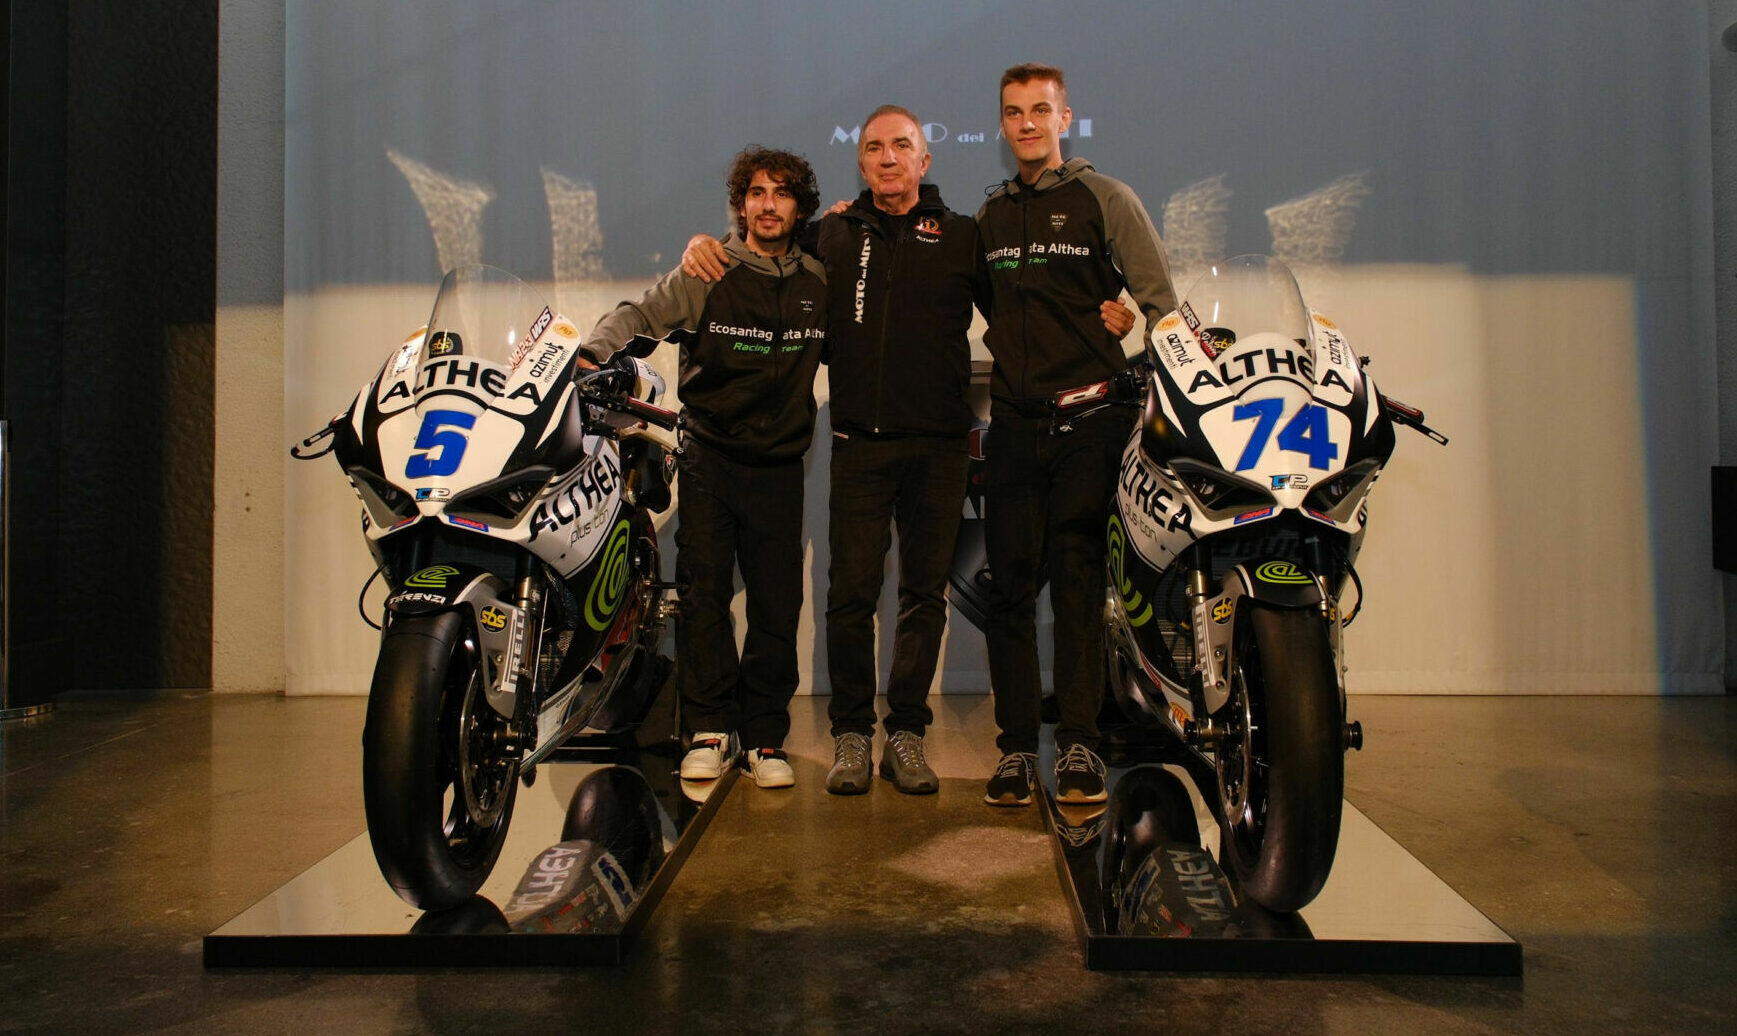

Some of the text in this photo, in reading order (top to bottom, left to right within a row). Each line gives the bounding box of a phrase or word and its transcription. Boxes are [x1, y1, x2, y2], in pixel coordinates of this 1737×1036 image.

[957, 132, 984, 143] dei
[915, 234, 940, 244] ALTHEA
[1048, 242, 1090, 256] Althea
[854, 279, 866, 324] MOTO
[709, 322, 773, 342] Ecosantag
[733, 342, 771, 354] Racing
[529, 341, 564, 378] azimut
[1166, 333, 1195, 367] azimut
[378, 359, 542, 406] ALTHEA
[1187, 348, 1354, 394] ALTHEA
[404, 409, 477, 479] 5
[1232, 397, 1338, 472] 74
[528, 454, 621, 543] ALTHEA
[1120, 449, 1198, 541] ALTHEA
[570, 523, 592, 548] plus
[480, 605, 507, 629] sbs
[1213, 598, 1232, 621] sbs
[500, 608, 526, 693] PIRELLI
